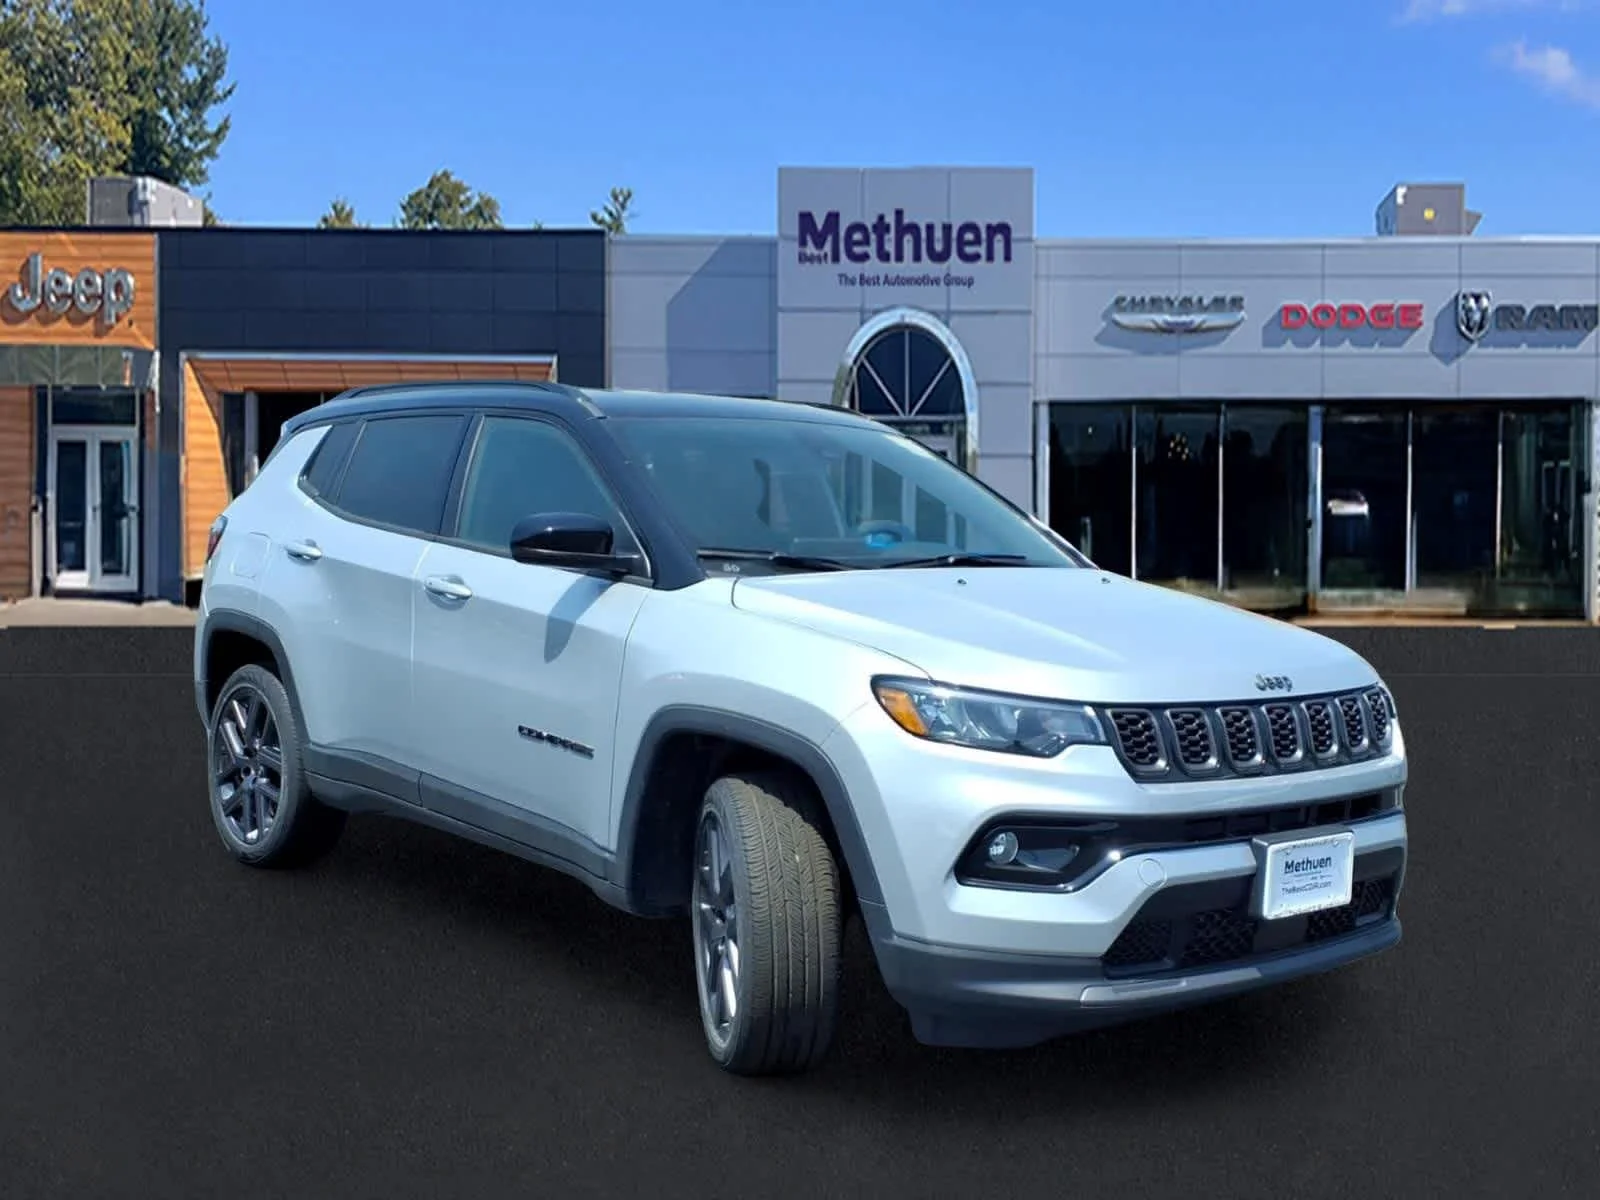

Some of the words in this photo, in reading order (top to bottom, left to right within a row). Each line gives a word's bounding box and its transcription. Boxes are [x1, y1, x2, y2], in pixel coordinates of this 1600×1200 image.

[798, 209, 1012, 264] Methuen
[9, 252, 135, 325] Jeep
[837, 273, 857, 287] The
[859, 273, 881, 287] Best
[883, 272, 941, 287] Automotive
[943, 273, 975, 288] Group
[1113, 295, 1245, 312] CHRYSLER
[1281, 303, 1424, 330] DODGE
[1495, 304, 1599, 331] RAM
[1255, 673, 1292, 692] Jeep
[1284, 856, 1332, 874] Methuen
